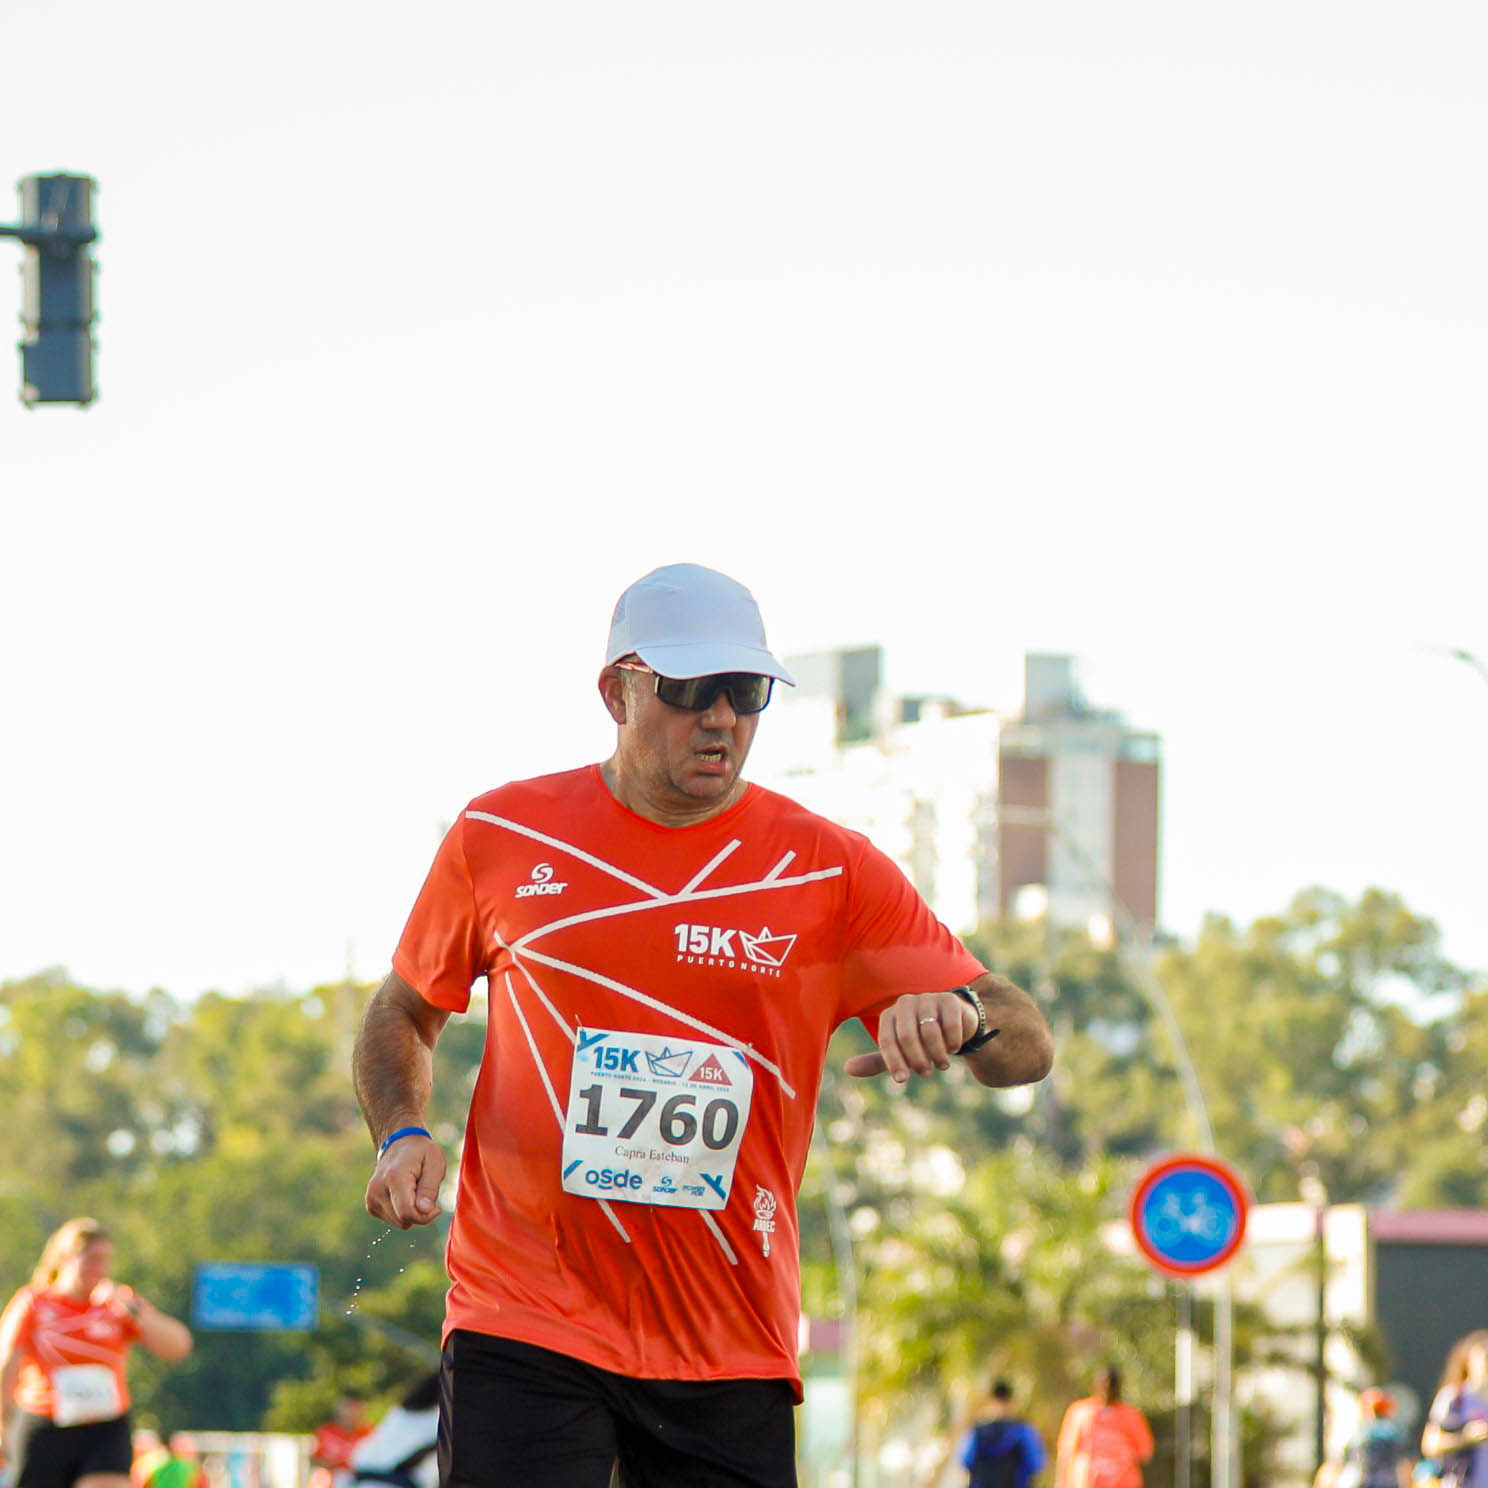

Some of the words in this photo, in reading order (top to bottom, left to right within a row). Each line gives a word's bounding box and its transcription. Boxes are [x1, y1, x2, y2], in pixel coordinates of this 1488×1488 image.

[674, 924, 737, 957] 15K
[677, 955, 735, 968] PUERTO
[741, 963, 781, 978] NORTE
[593, 1046, 641, 1072] 15K
[699, 1067, 724, 1080] 15K
[575, 1083, 739, 1151] 1760
[615, 1146, 646, 1160] Capra
[649, 1148, 690, 1164] Esteban
